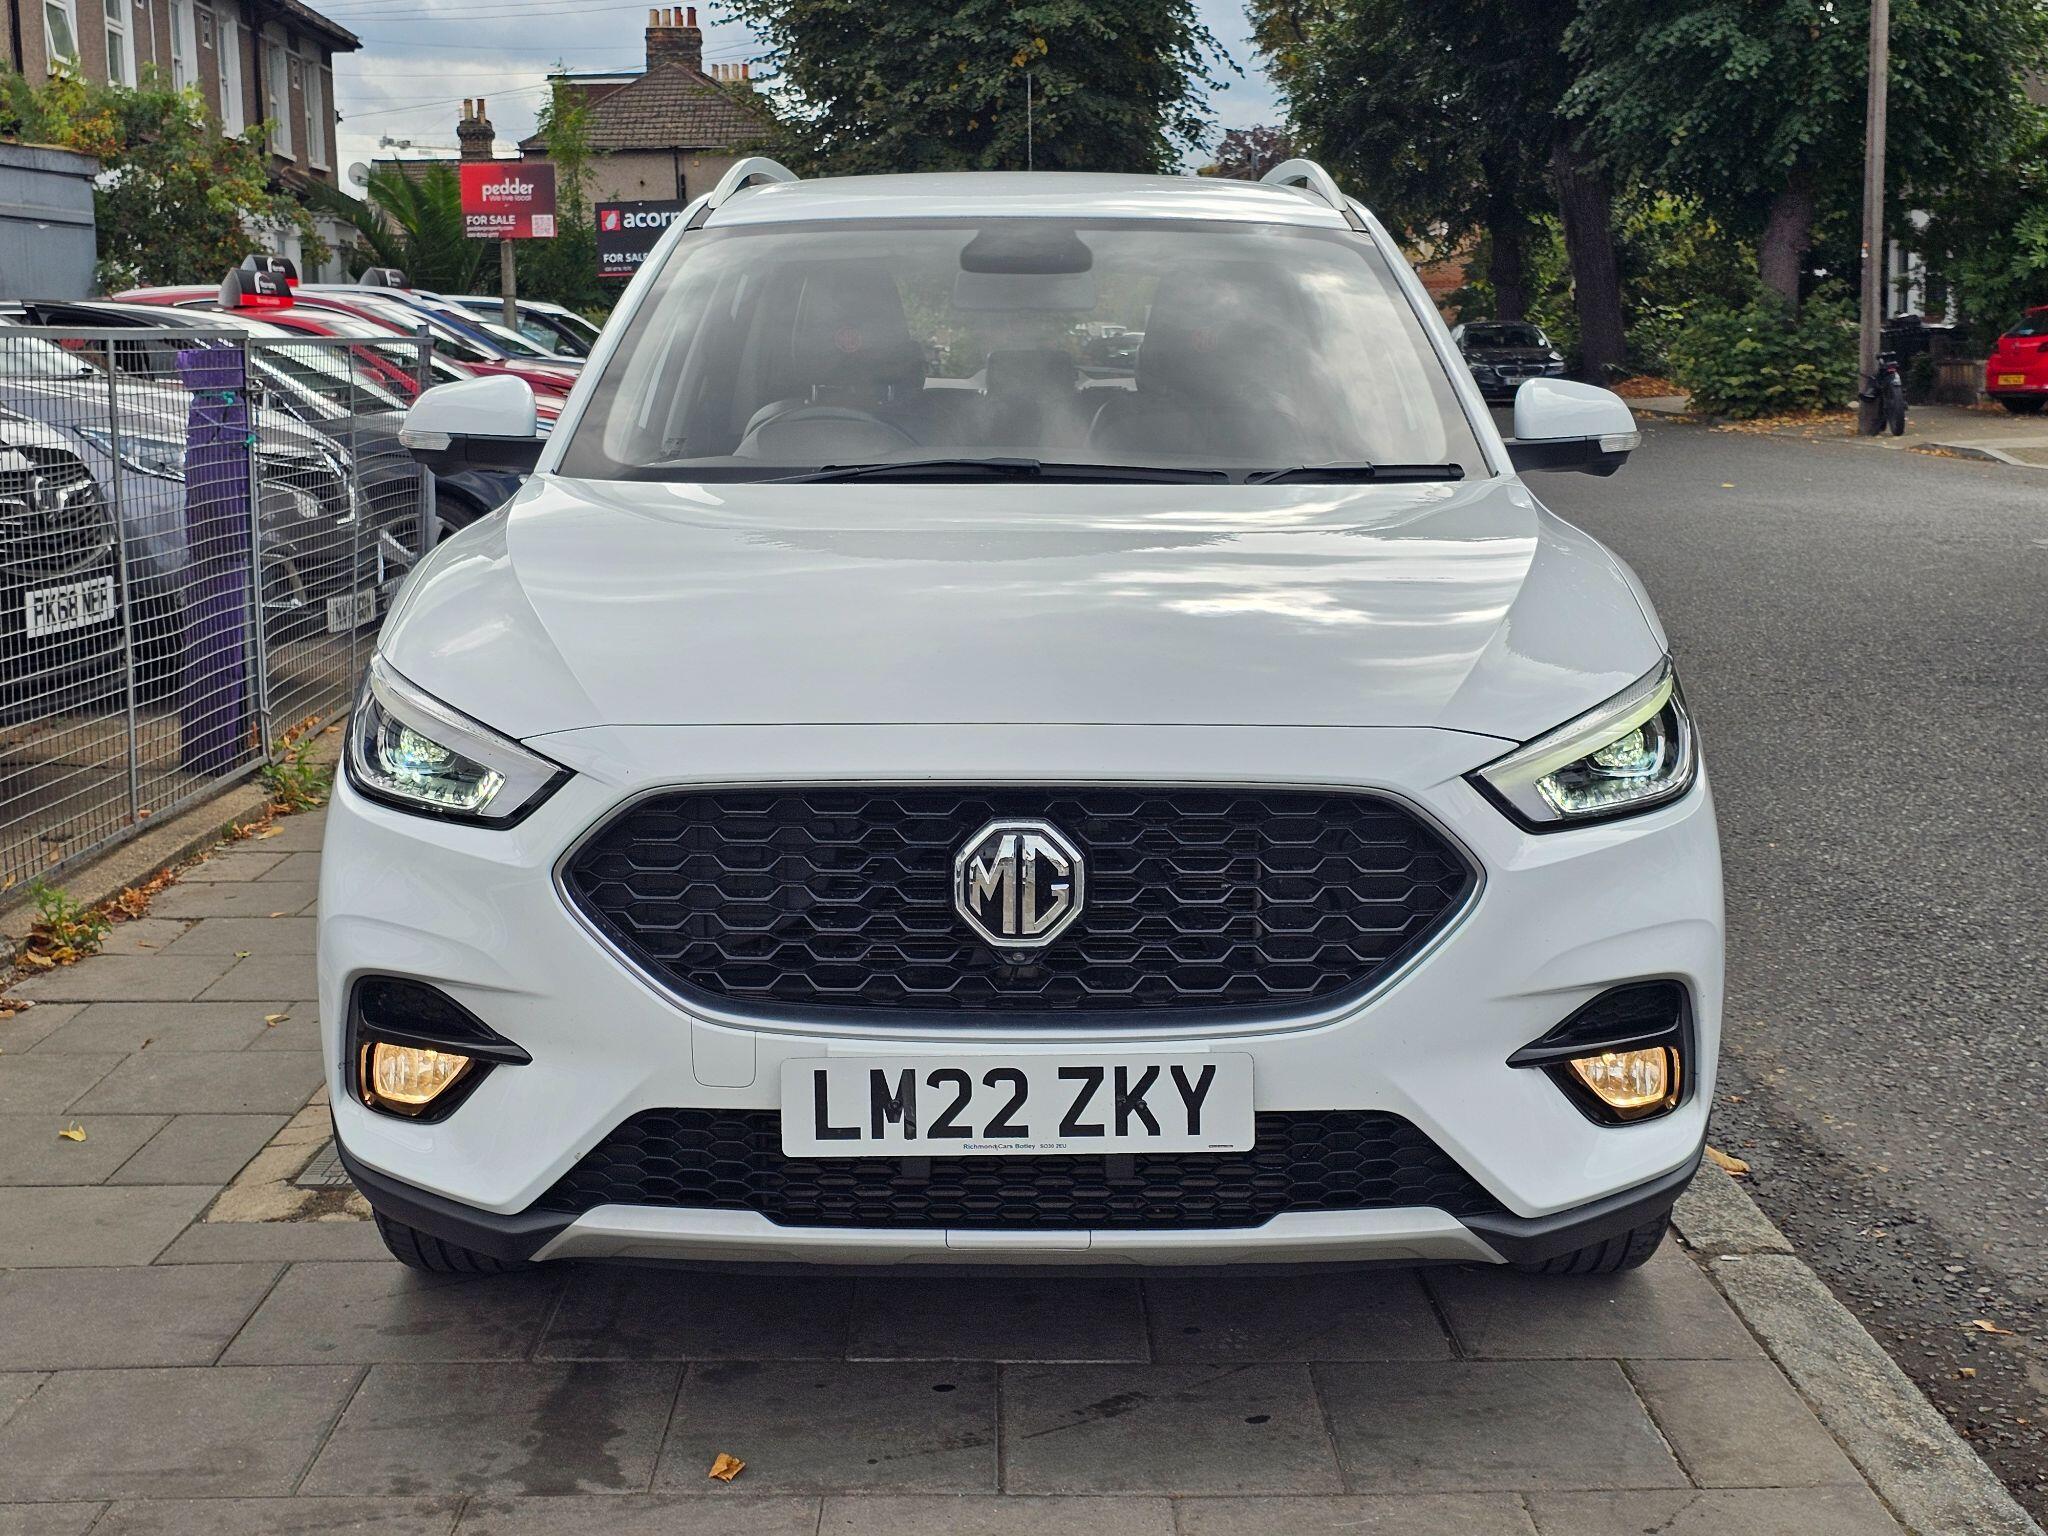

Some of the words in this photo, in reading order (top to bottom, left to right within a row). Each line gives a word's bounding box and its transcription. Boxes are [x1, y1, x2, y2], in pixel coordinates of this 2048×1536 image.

[482, 177, 534, 202] pedder
[466, 215, 487, 226] FOR
[489, 214, 516, 225] SALE
[603, 253, 624, 263] FOR
[969, 834, 1070, 935] MG
[813, 1068, 1030, 1140] LM22
[1058, 1065, 1216, 1138] ZKY
